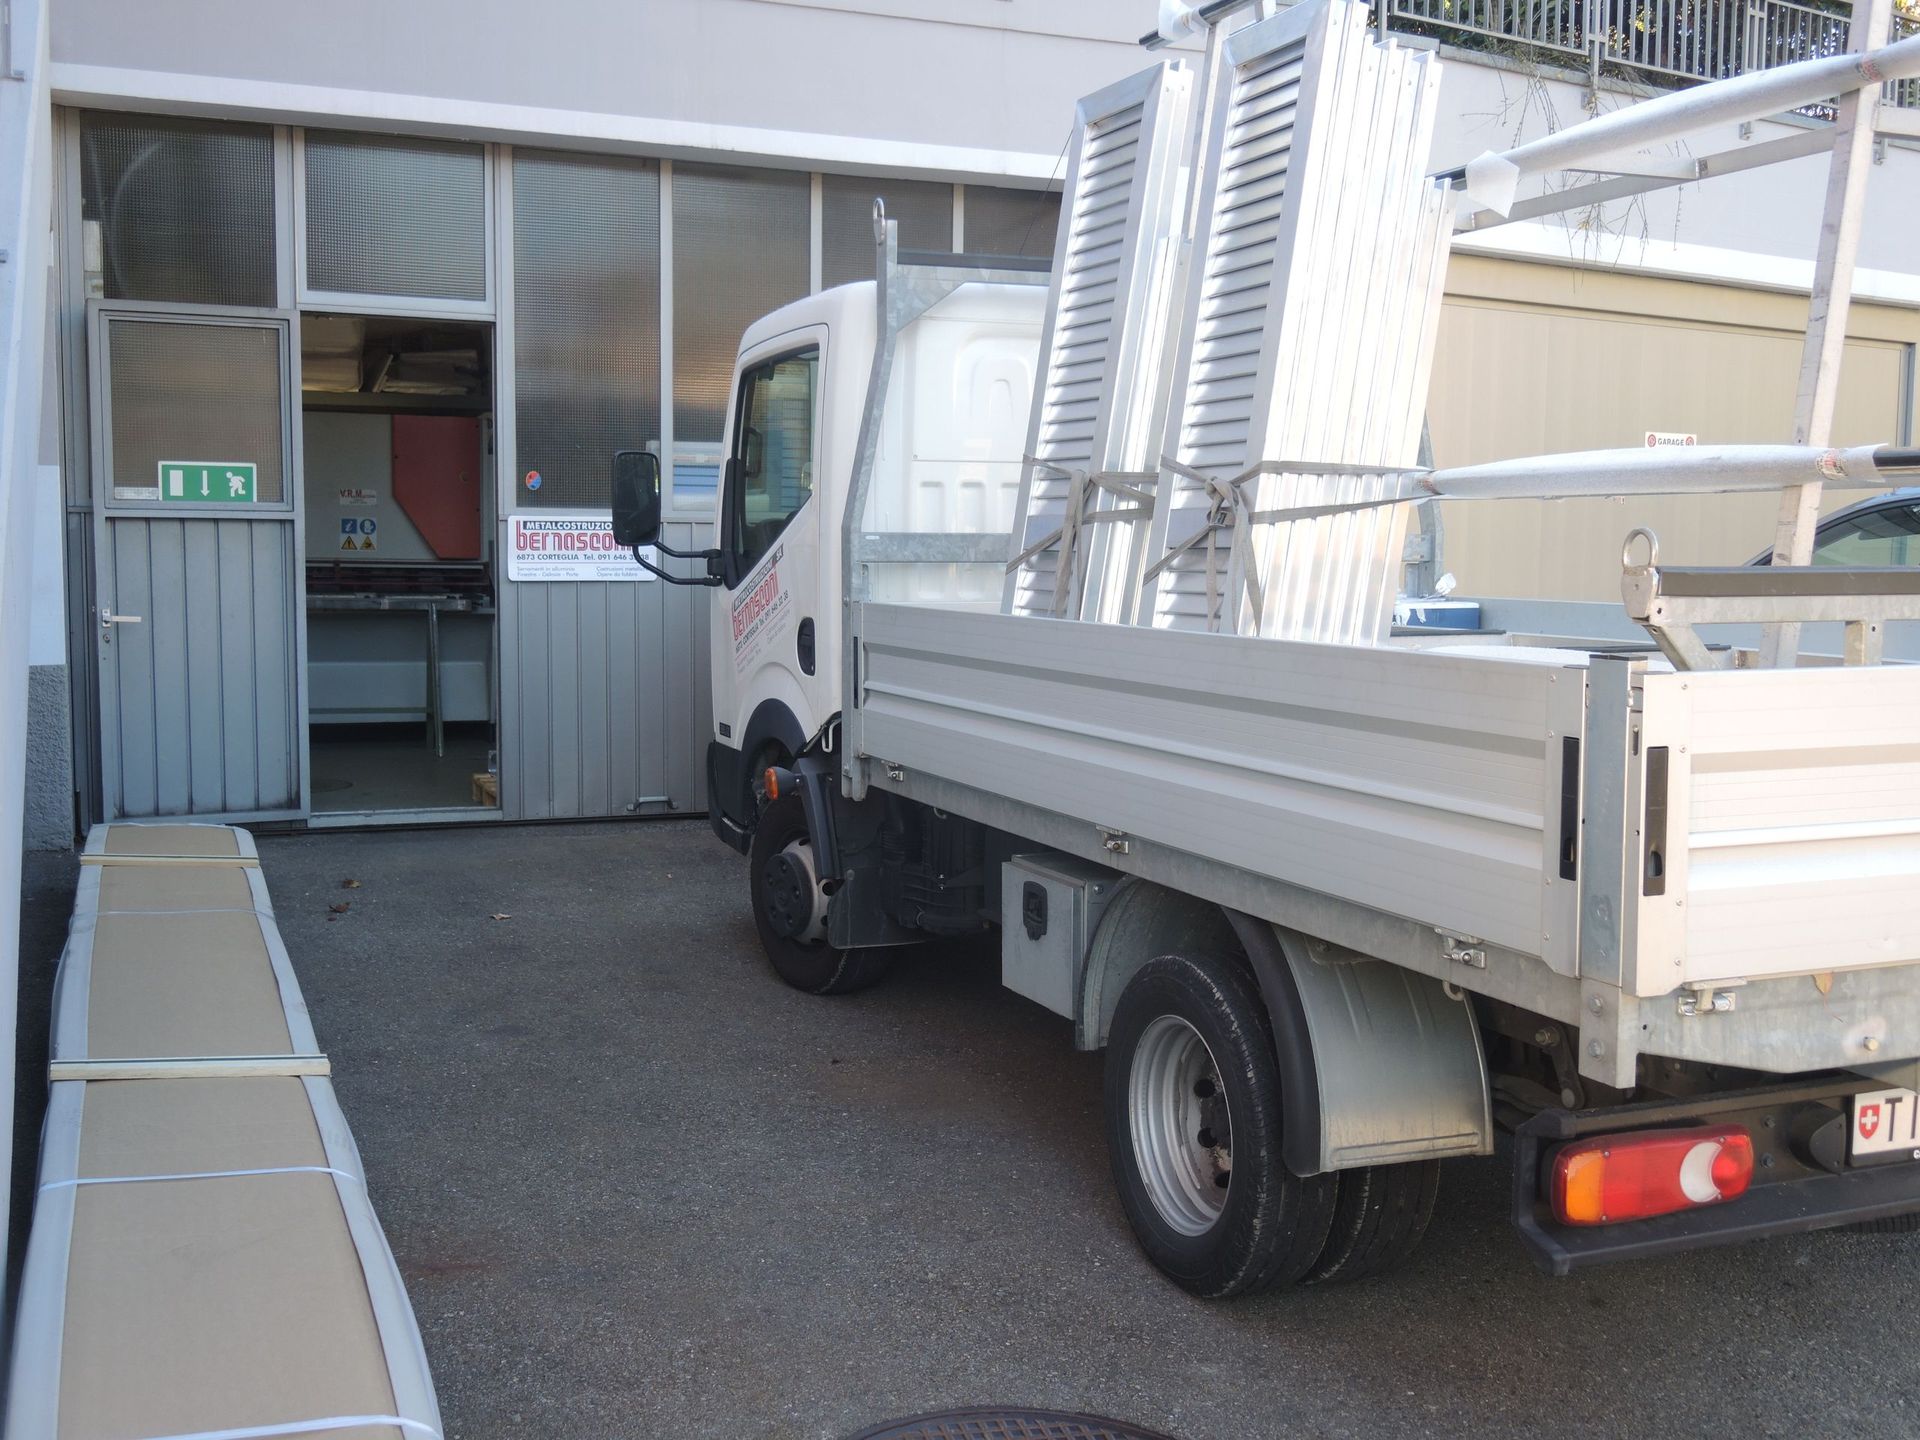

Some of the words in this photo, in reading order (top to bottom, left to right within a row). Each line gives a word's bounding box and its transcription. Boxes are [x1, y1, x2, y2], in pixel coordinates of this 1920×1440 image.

[1657, 438, 1685, 446] GARAGE
[526, 521, 613, 531] METALCOSTRUZIO
[516, 520, 632, 551] bernasco
[516, 553, 535, 561] 6873
[537, 553, 580, 561] CORTEGLIA
[583, 553, 596, 561] Tel.
[597, 553, 611, 561] 091
[613, 553, 627, 561] 646
